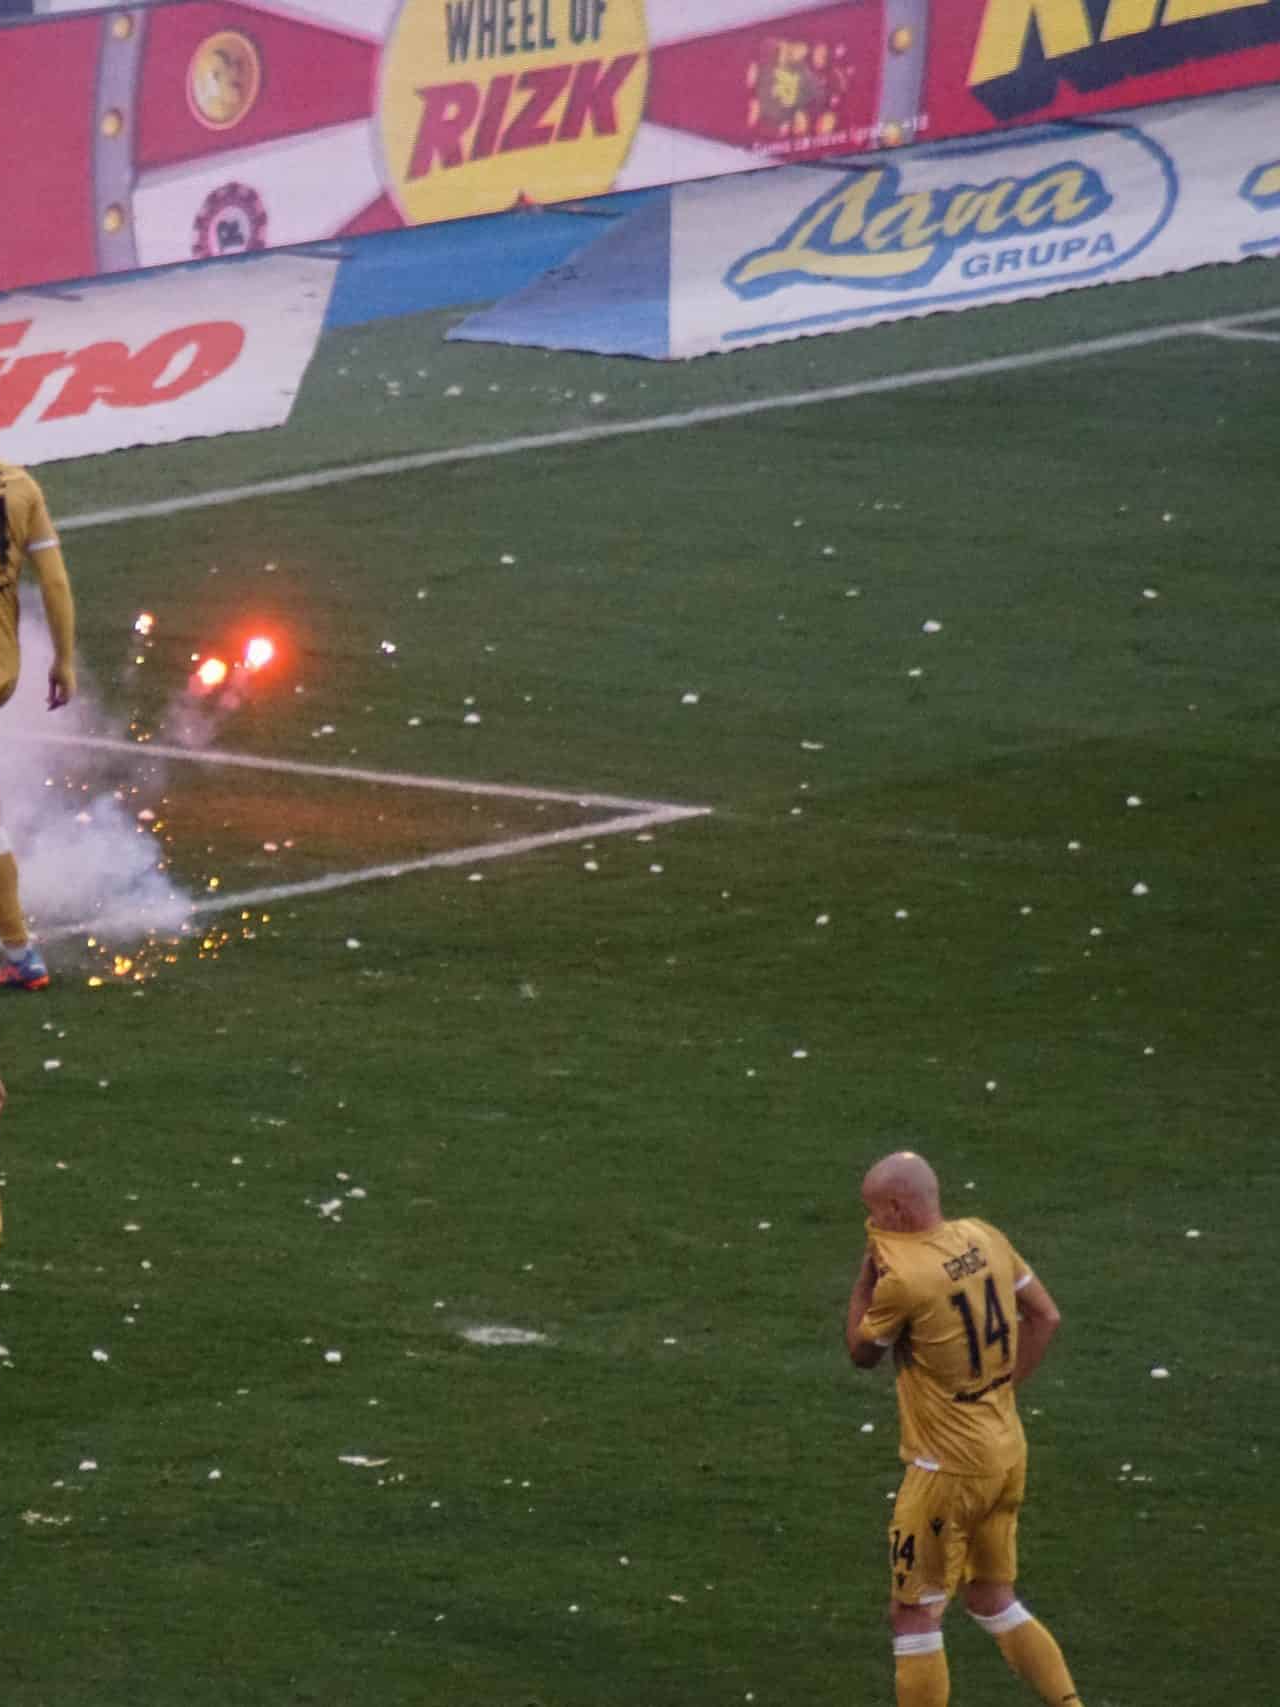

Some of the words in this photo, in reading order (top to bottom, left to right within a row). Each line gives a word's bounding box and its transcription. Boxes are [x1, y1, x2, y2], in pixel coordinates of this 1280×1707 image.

[446, 0, 555, 62] WHEEL
[405, 53, 640, 182] RIZK
[961, 232, 1116, 280] GRUPA
[949, 1273, 1011, 1379] 14
[892, 1529, 915, 1572] 14
